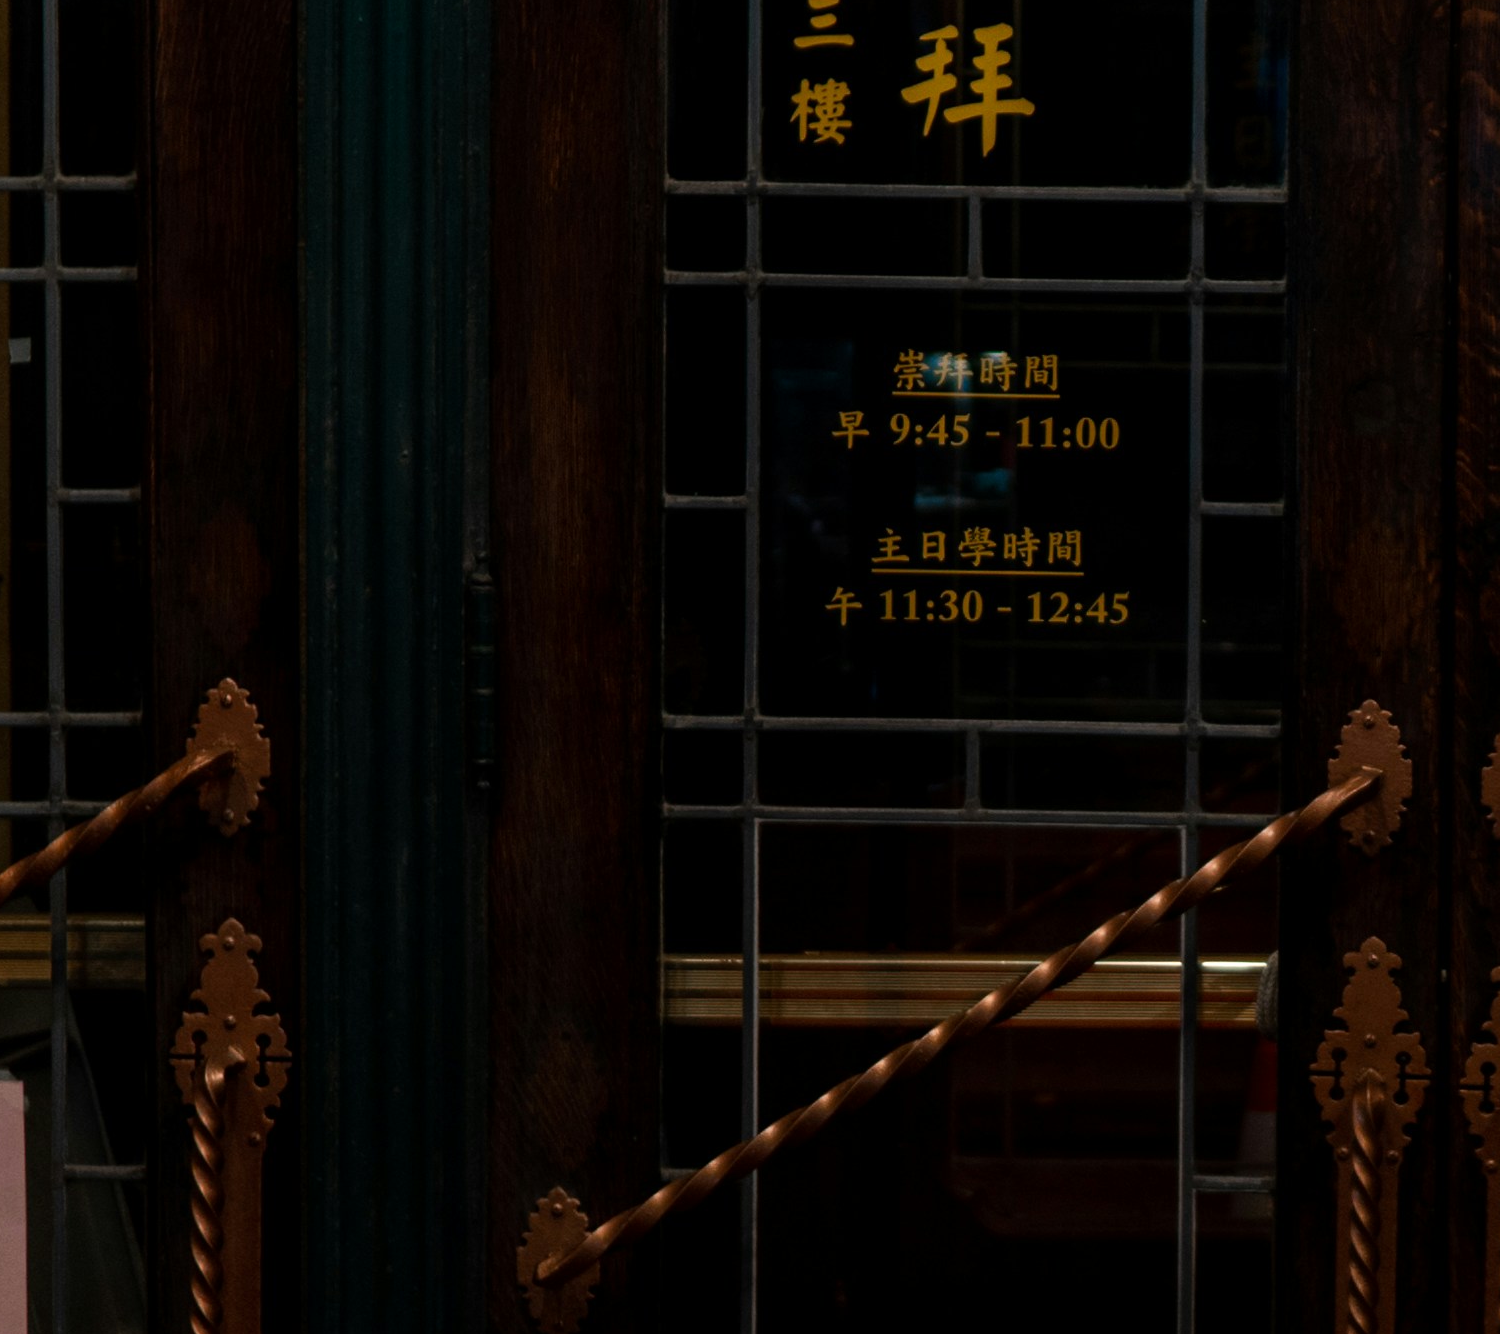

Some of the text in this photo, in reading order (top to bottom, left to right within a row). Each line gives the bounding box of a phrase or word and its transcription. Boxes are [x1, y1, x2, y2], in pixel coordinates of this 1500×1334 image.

[892, 348, 1059, 393] 崇拜時間
[832, 409, 870, 450] 早
[888, 412, 971, 448] 9:45
[1016, 415, 1121, 451] 11:00
[870, 526, 1083, 569] 主日學時間
[825, 585, 864, 627] 午
[882, 588, 984, 623] 11:30
[1027, 590, 1130, 626] 12:45
